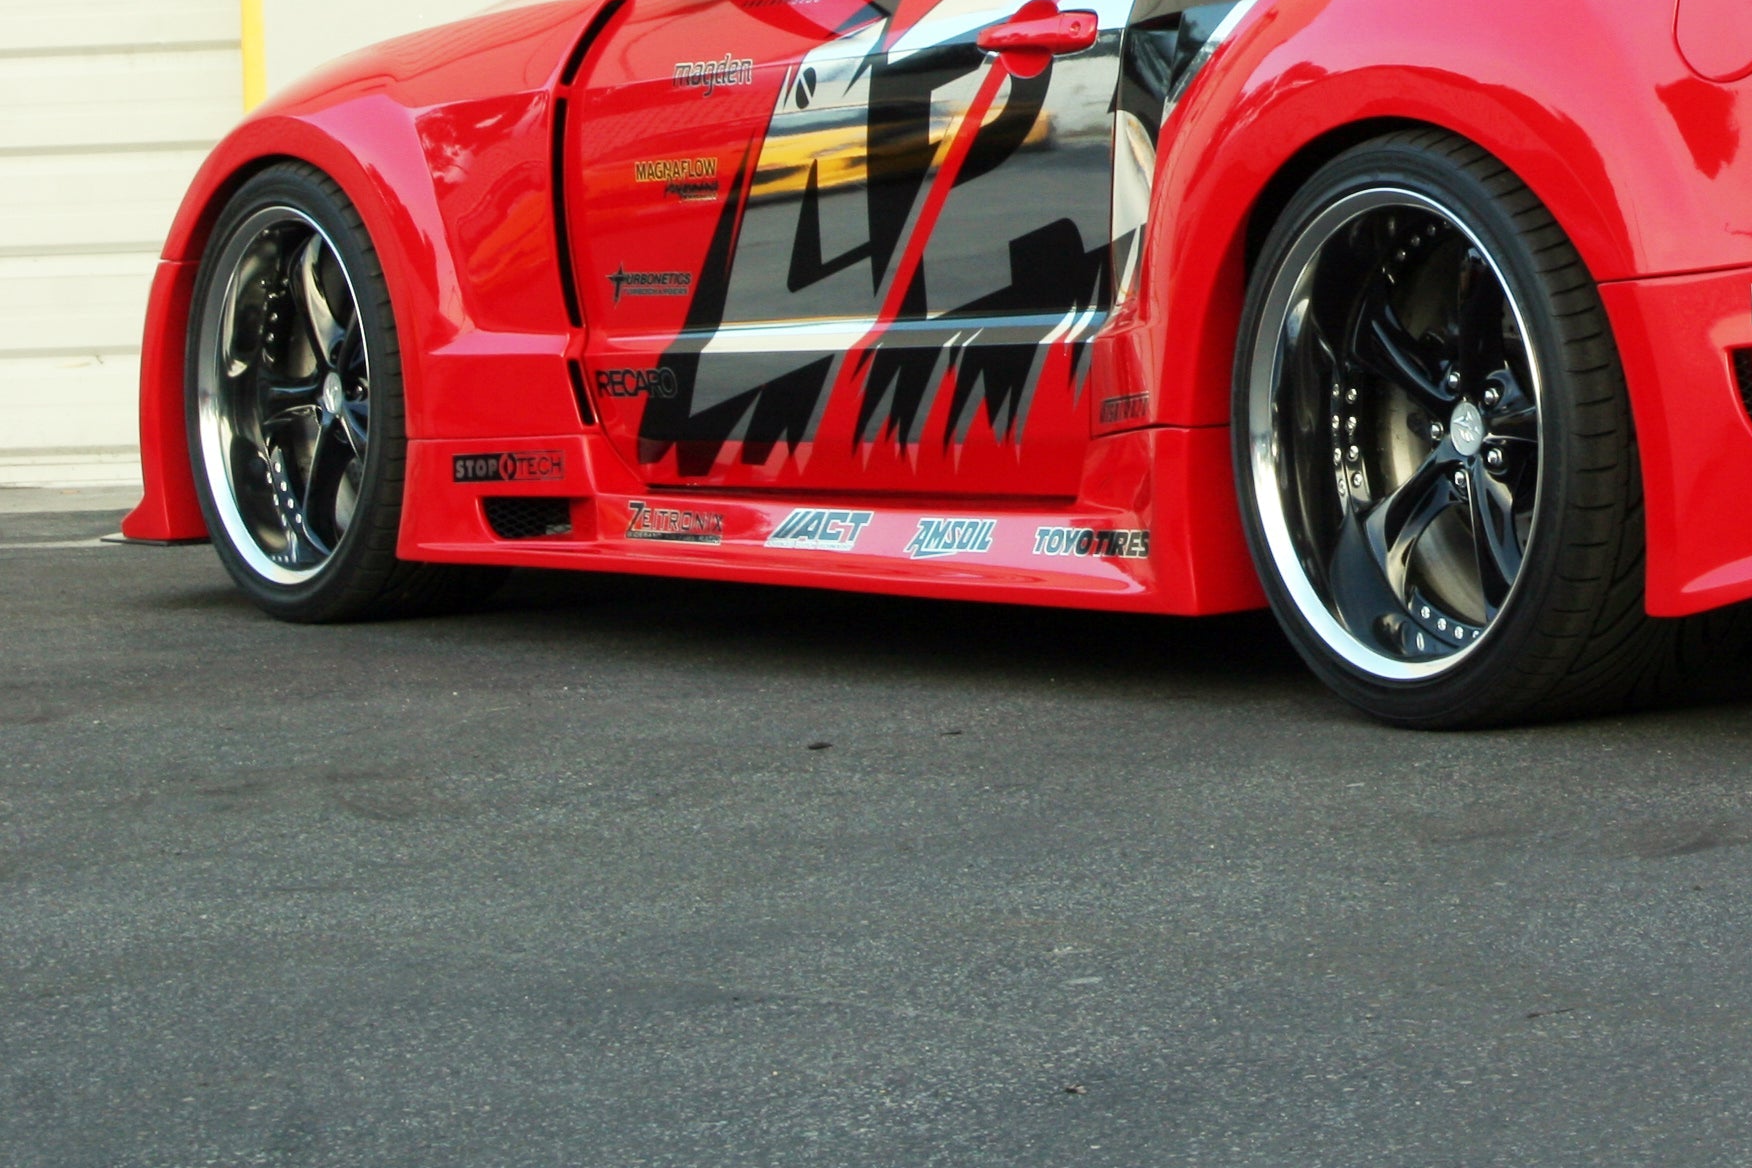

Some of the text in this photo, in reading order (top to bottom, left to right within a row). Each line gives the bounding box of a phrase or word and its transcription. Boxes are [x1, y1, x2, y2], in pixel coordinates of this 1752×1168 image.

[673, 53, 753, 98] magden
[634, 157, 717, 182] MAGNAFLOW
[596, 367, 678, 398] RECARO
[456, 456, 561, 479] STOP TECH
[625, 500, 723, 533] ZEITRONIX
[903, 518, 997, 559] AMSOIL
